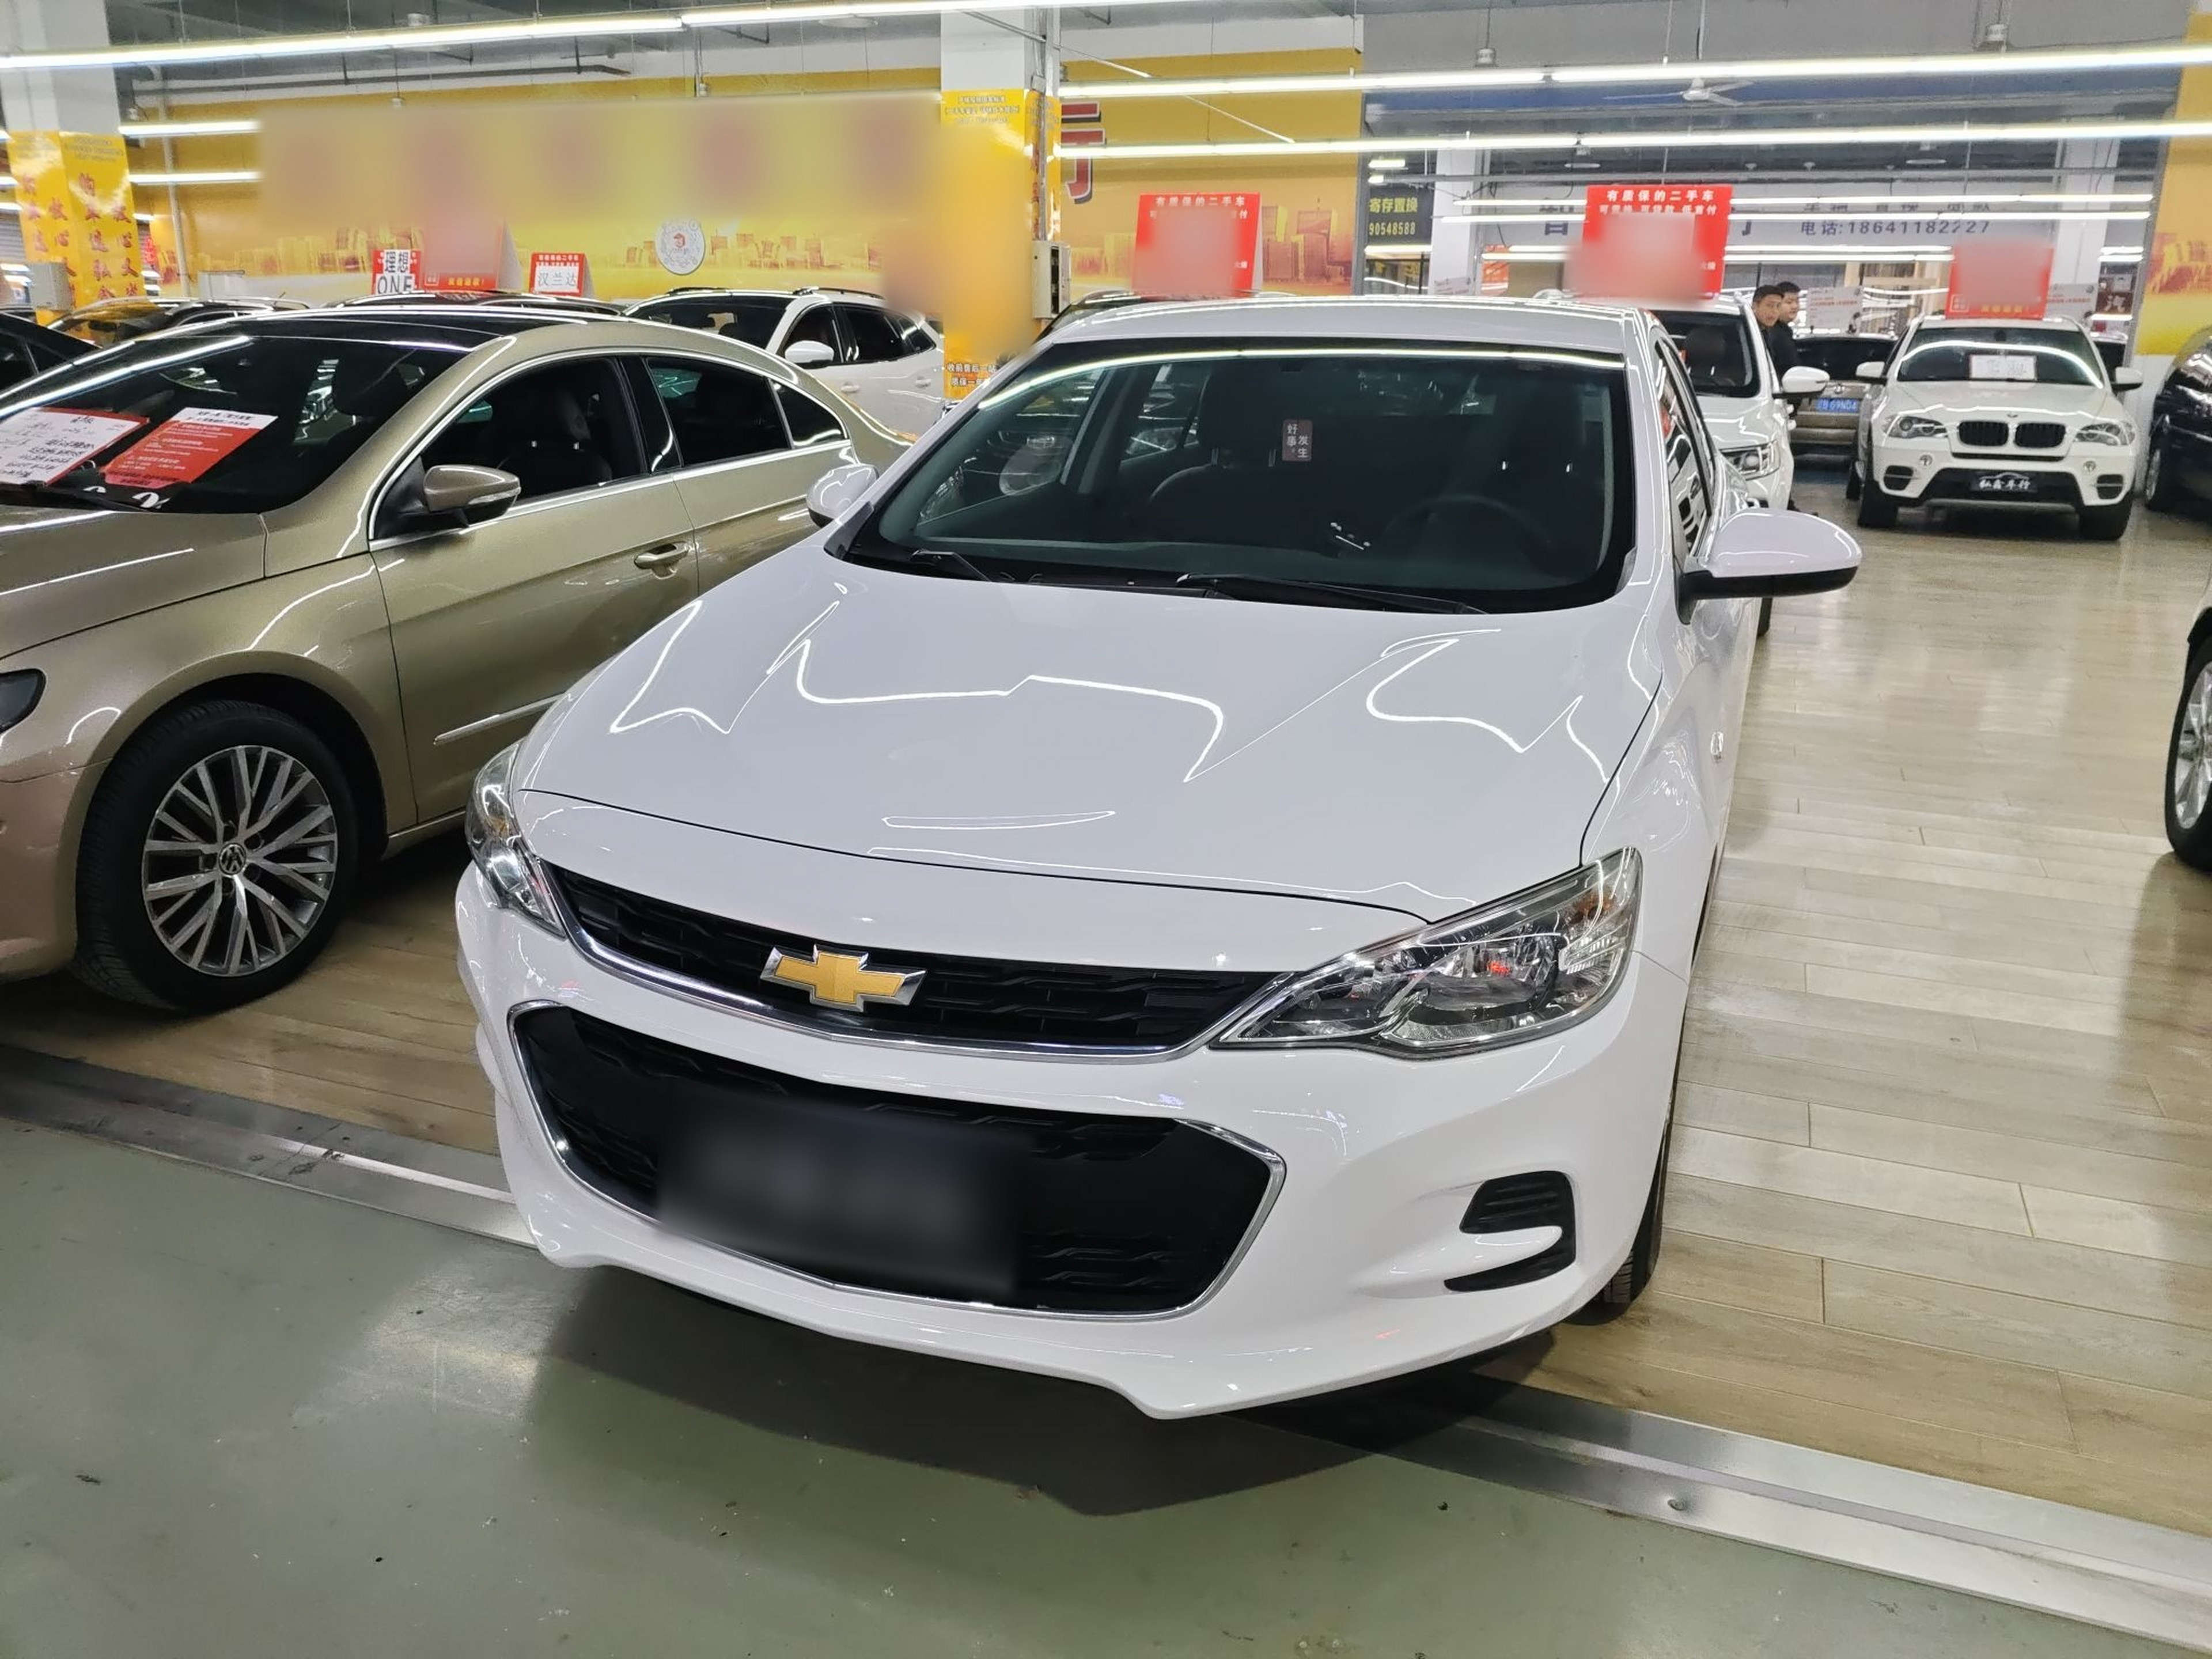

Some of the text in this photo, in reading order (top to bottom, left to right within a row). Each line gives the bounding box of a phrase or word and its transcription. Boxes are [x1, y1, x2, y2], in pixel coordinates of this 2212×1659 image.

[1607, 190, 1714, 202] 有质保的二手车
[1369, 222, 1416, 236] 90548588
[385, 251, 409, 273] 理想
[377, 275, 413, 294] ONE
[537, 271, 577, 287] 汉兰达
